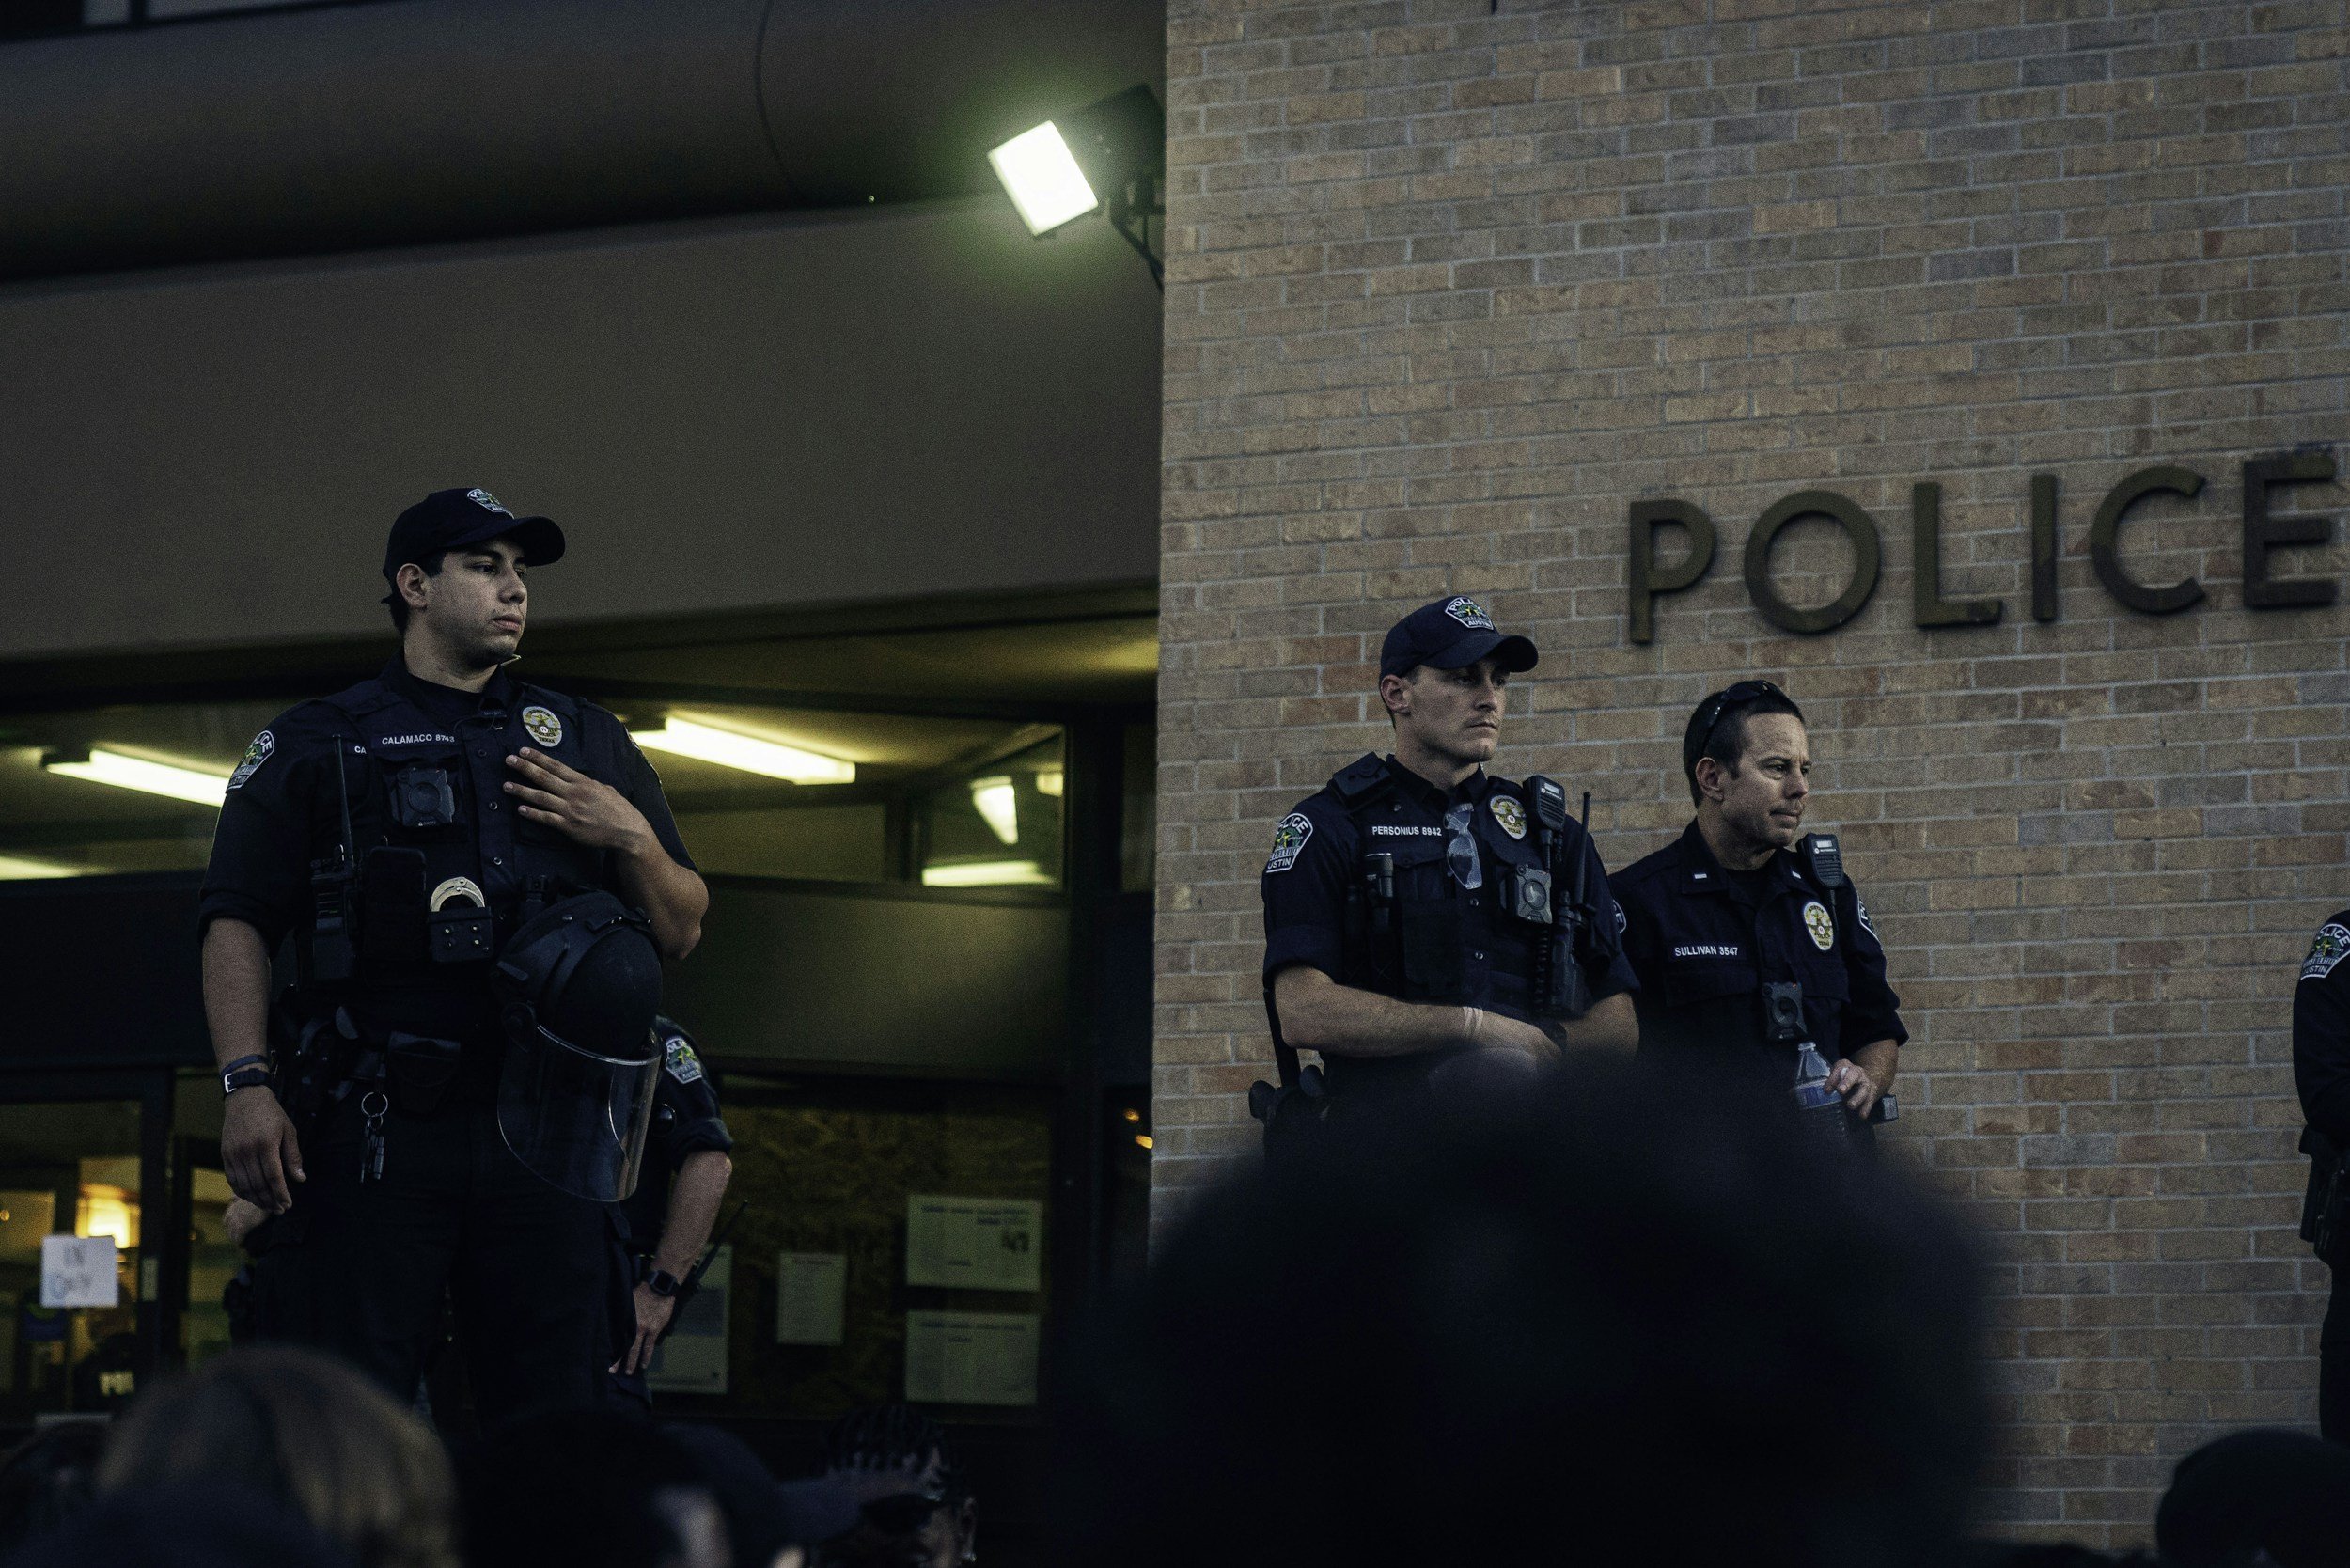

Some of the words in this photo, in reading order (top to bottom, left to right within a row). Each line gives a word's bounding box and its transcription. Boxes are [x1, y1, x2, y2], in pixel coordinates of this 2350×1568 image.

[1629, 449, 2338, 645] POLICE
[382, 734, 432, 745] CALAMACO
[435, 734, 455, 743] 8743
[1372, 826, 1419, 836] PERSONIUS
[1421, 827, 1442, 836] 8942
[1267, 857, 1292, 869] USTIN
[1675, 946, 1717, 957] SULLIVAN
[1718, 947, 1738, 956] 3547
